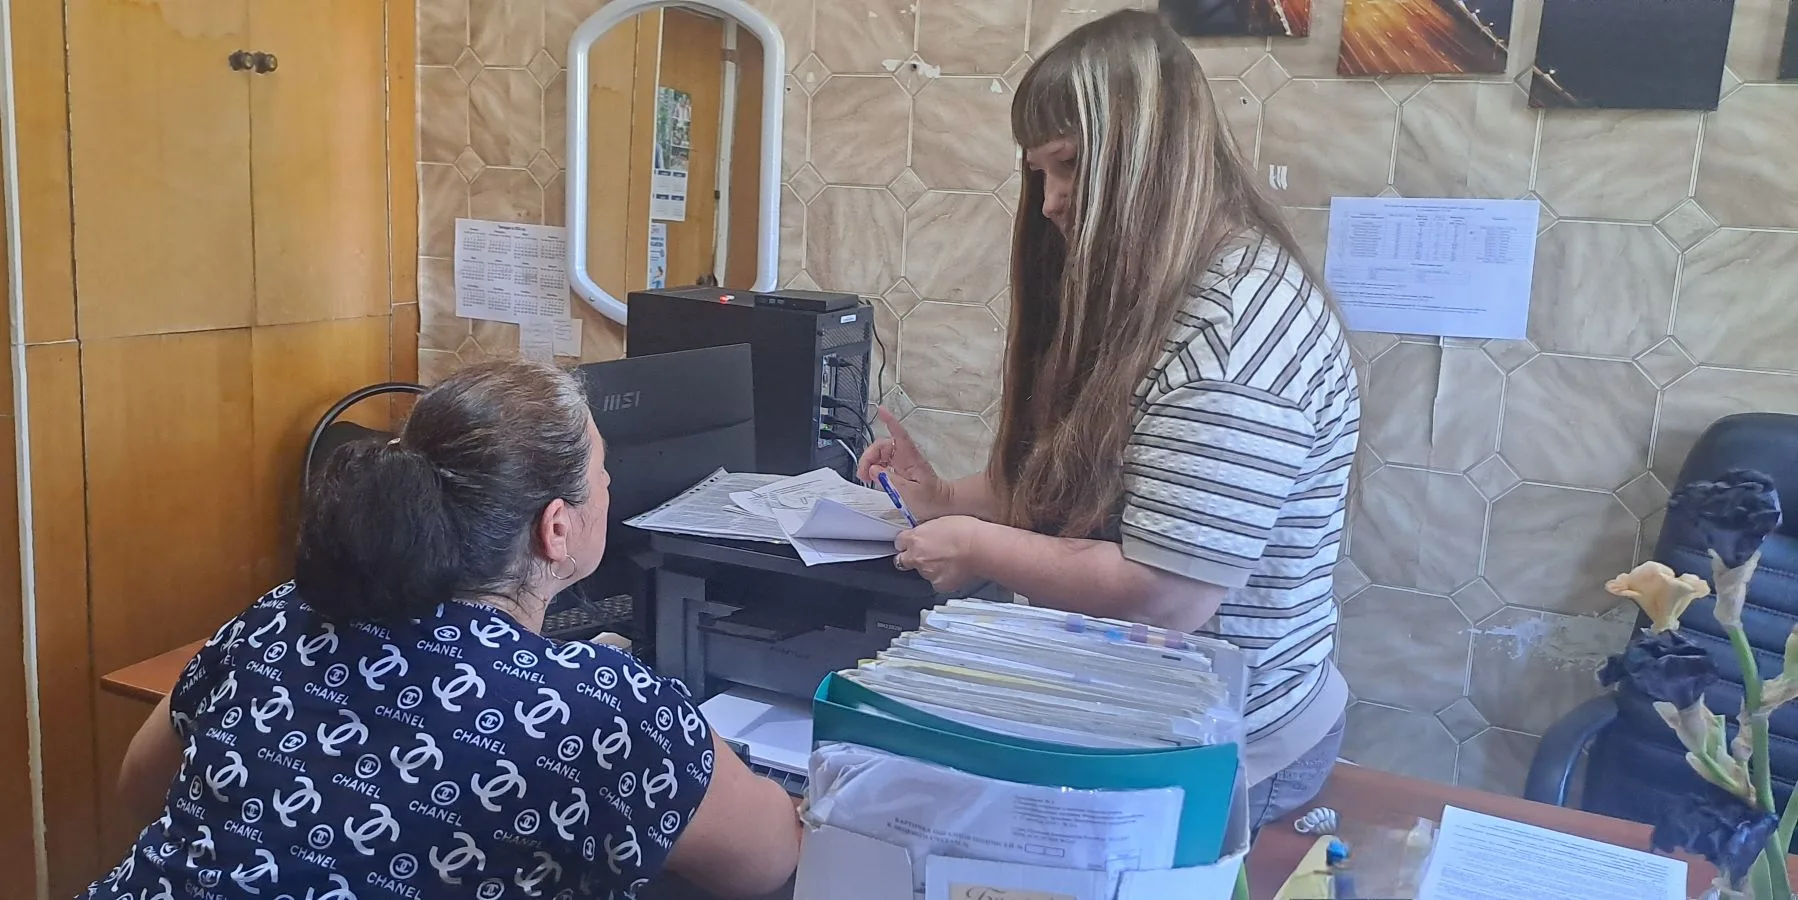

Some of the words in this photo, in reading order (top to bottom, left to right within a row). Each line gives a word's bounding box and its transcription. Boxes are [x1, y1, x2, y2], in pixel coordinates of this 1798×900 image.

[604, 391, 640, 412] MSI
[416, 640, 463, 659] CHANEL
[180, 665, 206, 696] HANEL
[246, 660, 282, 681] CHANEL
[493, 660, 546, 684] CHANEL
[304, 682, 349, 706] CHANEL
[577, 682, 622, 712] CHANEL
[375, 705, 425, 729] CHANEL
[206, 727, 237, 746] CHANEL
[453, 728, 506, 755] CHANEL
[640, 720, 673, 754] CHANEL
[258, 747, 307, 772] CHANEL
[536, 756, 581, 783] CHANEL
[332, 773, 381, 799] CHANEL
[686, 762, 709, 787] CHAN
[176, 798, 206, 820] CHANEL
[409, 800, 463, 827] CHANEL
[599, 786, 633, 820] CHANEL
[224, 820, 264, 843] CHANEL
[647, 826, 673, 849] CHAN
[290, 845, 337, 869] CHANEL
[366, 872, 423, 900] CHANEL
